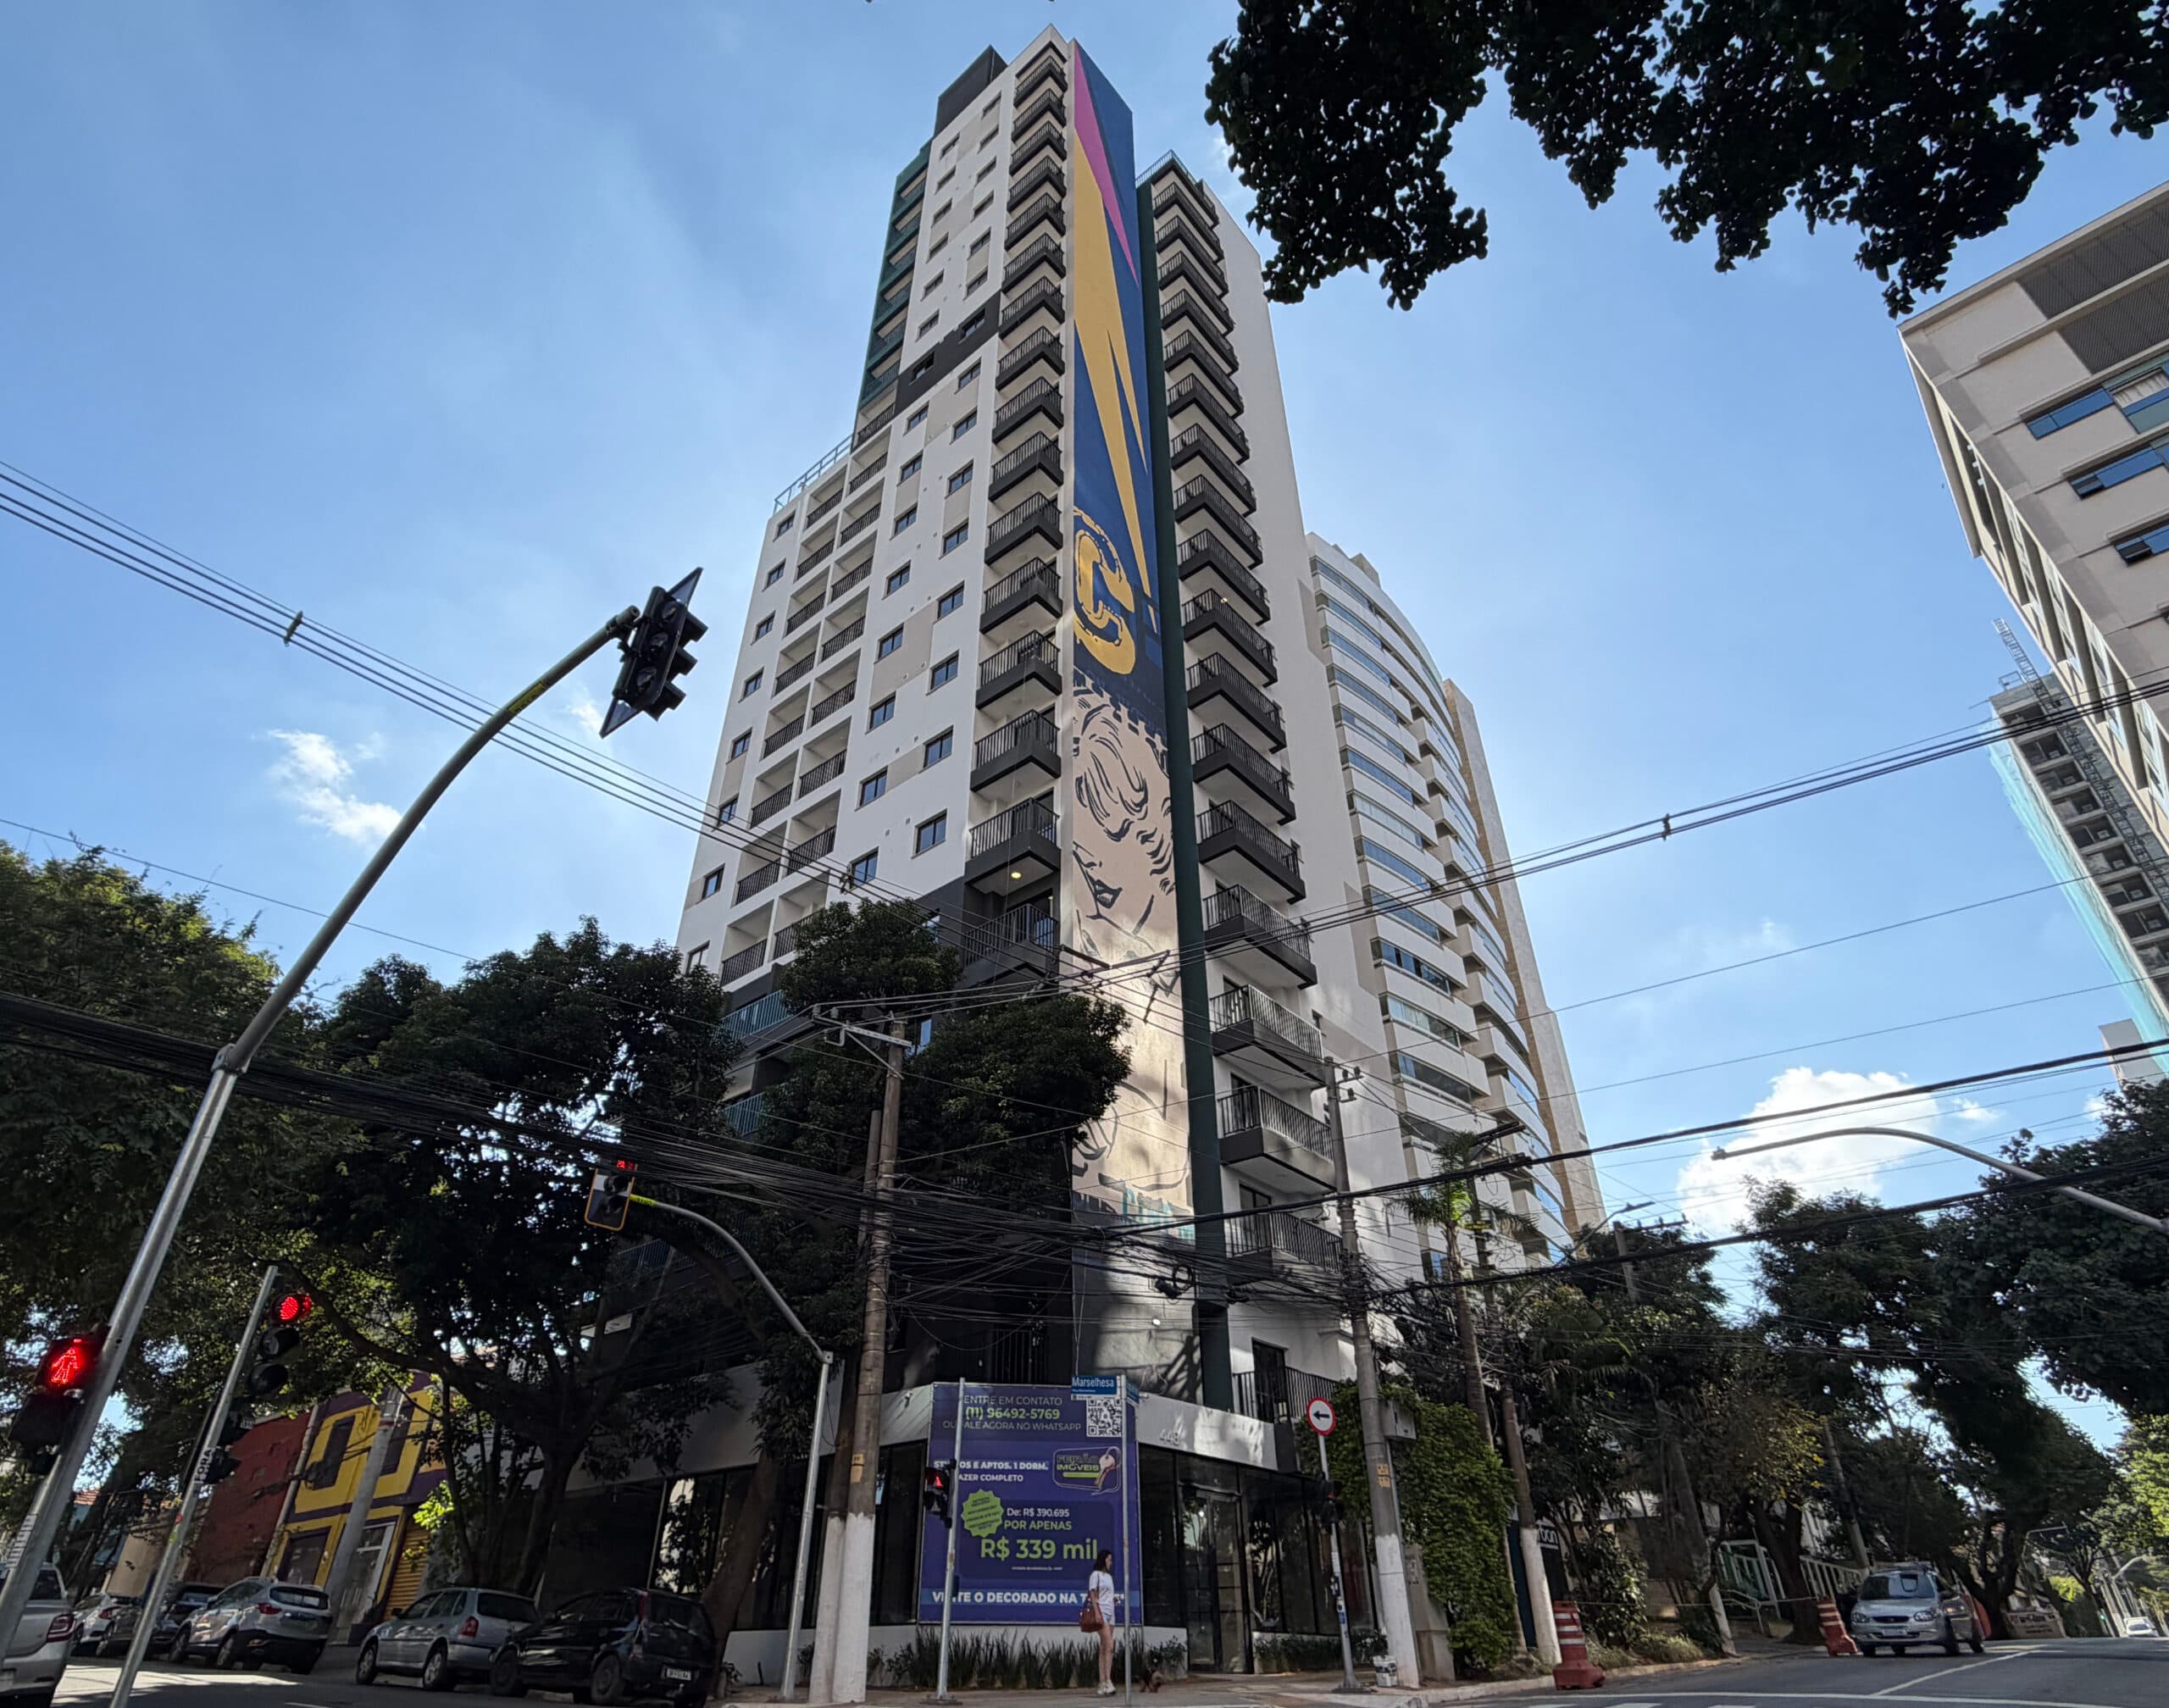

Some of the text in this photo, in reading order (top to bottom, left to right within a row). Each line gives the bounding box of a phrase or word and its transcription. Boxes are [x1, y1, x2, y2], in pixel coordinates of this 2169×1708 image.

[1072, 1377, 1114, 1388] Marselhesa
[964, 1395, 1062, 1406] ENTRE EM CONTATO
[966, 1406, 1060, 1420] (11) 96492-5769
[962, 1421, 981, 1429] ALE
[982, 1422, 1014, 1430] AGORA
[1033, 1422, 1081, 1431] WHATSAPP
[980, 1461, 1012, 1470] APTOS.
[1019, 1462, 1049, 1471] DORM.
[1007, 1508, 1021, 1517] De:
[1023, 1508, 1035, 1517] R$
[1036, 1509, 1070, 1517] 390.695
[1004, 1520, 1026, 1530] POR
[1029, 1521, 1072, 1530] APENAS
[980, 1535, 1098, 1561] R$ 339 mil
[932, 1591, 971, 1602] VITE
[974, 1592, 984, 1603] O
[987, 1592, 1057, 1604] DECORADO
[1059, 1593, 1078, 1604] NA
